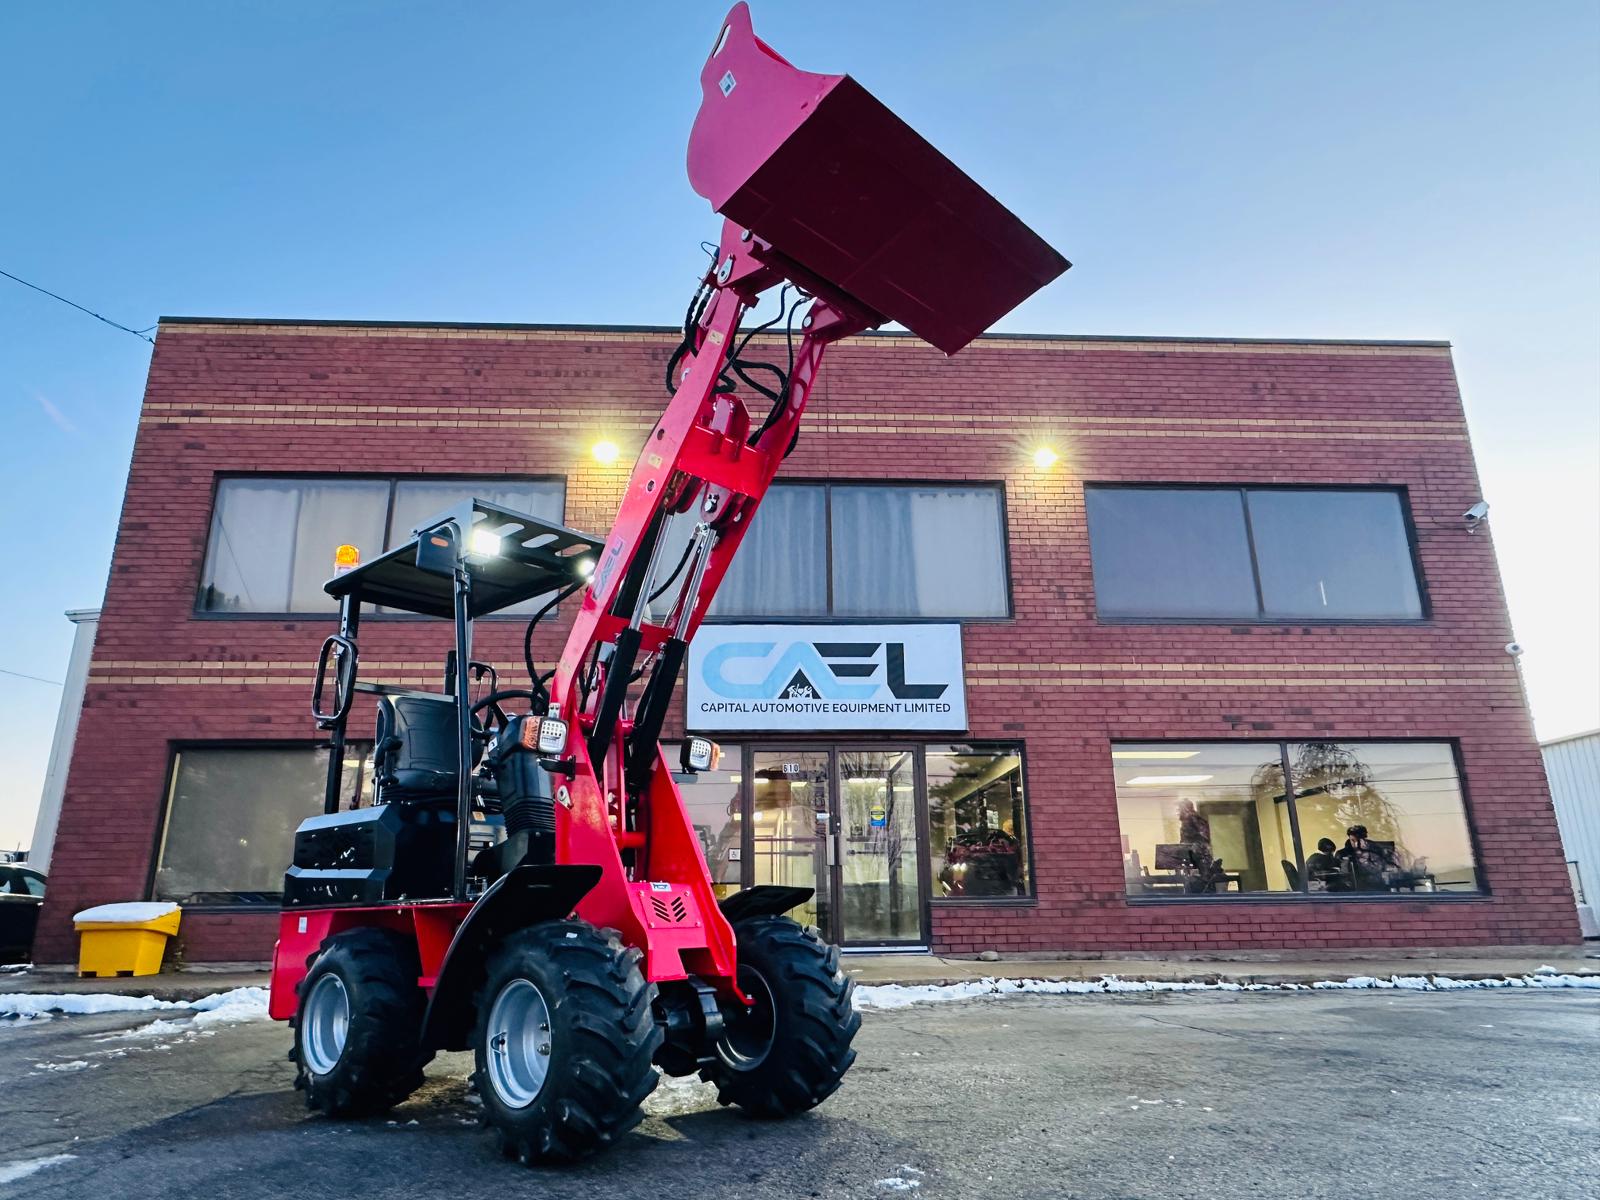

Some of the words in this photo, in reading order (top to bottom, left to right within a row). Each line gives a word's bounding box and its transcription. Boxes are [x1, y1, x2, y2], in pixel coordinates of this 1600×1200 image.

[702, 641, 949, 699] CAEL
[700, 702, 750, 713] CAPITAL
[751, 703, 830, 713] AUTOMOTIVE
[832, 703, 902, 713] EQUIPMENT
[904, 703, 951, 713] LIMITED
[783, 763, 800, 773] 610
